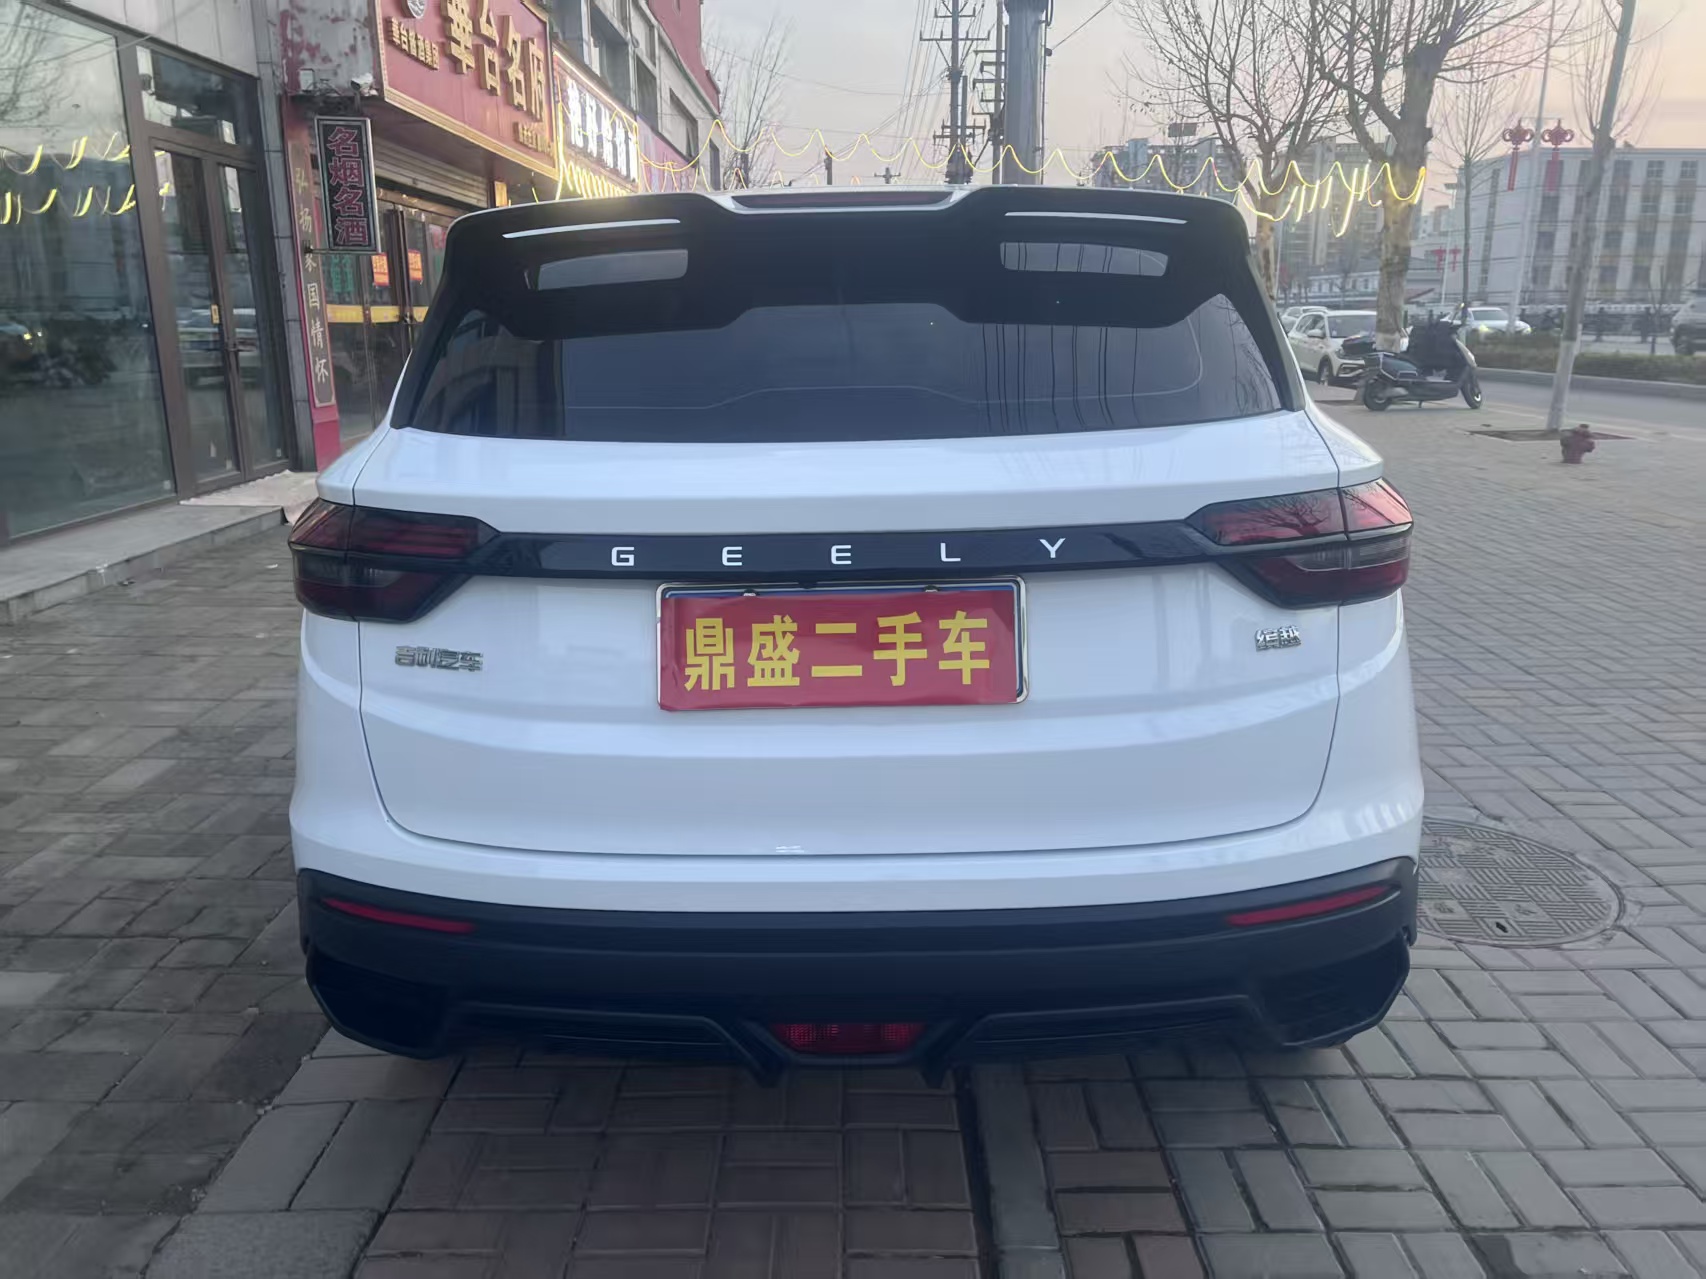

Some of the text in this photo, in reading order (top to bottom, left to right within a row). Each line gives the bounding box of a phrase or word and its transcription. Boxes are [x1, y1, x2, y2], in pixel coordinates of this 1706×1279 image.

[327, 127, 368, 245] 名烟名酒
[611, 538, 1066, 567] GEELY
[395, 646, 483, 671] 吉利汽车
[684, 610, 990, 691] 鼎盛二手车
